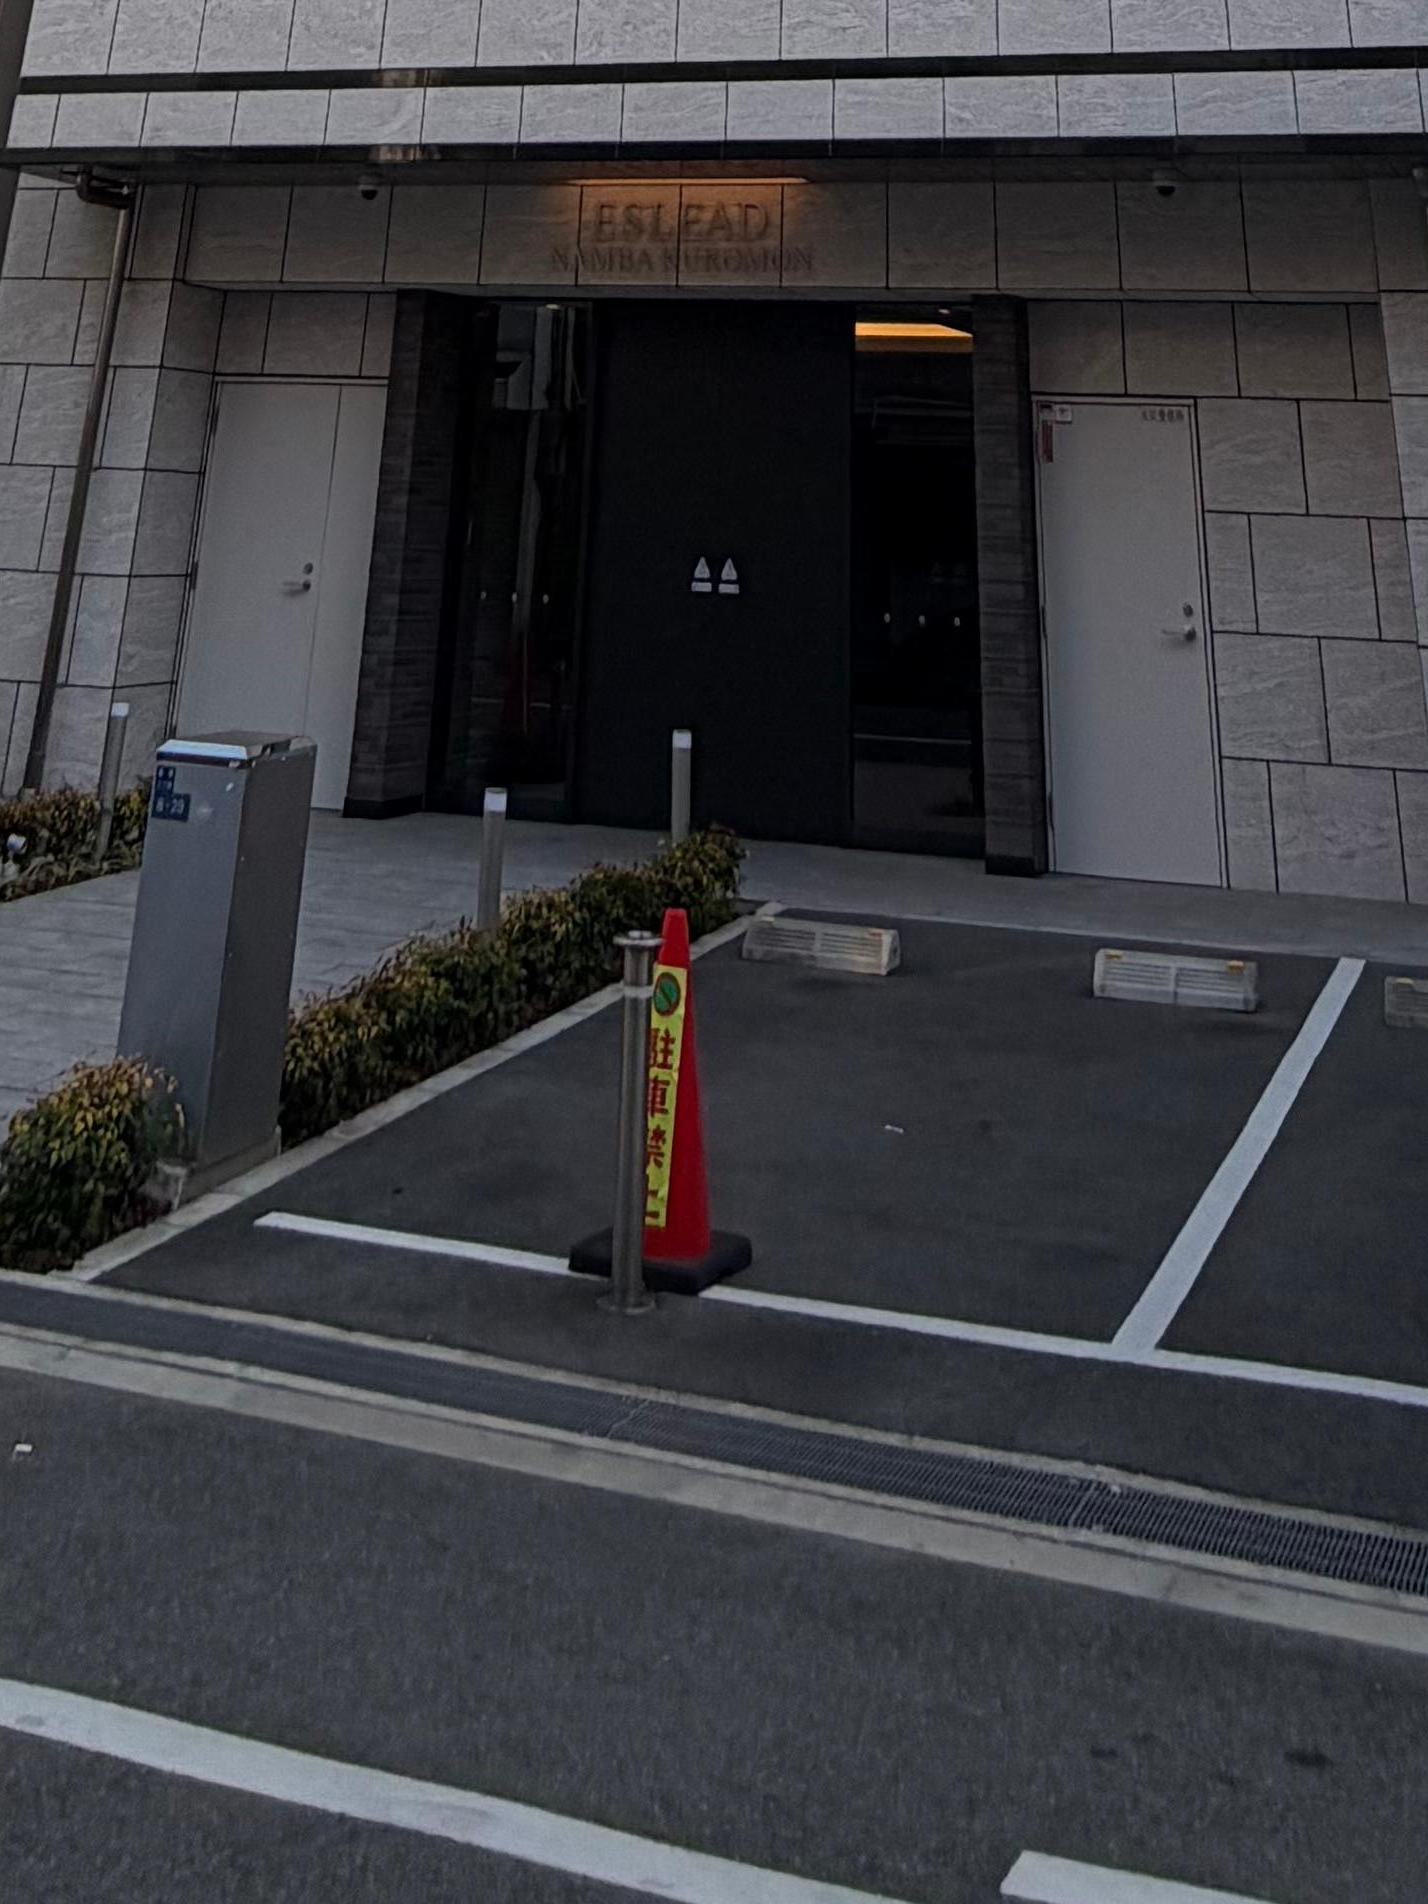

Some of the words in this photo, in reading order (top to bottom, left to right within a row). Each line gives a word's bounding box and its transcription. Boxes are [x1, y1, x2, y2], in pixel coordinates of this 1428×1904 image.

[594, 202, 771, 243] ESLEAD
[550, 245, 655, 275] NAMBA
[665, 244, 815, 274] KUROMON
